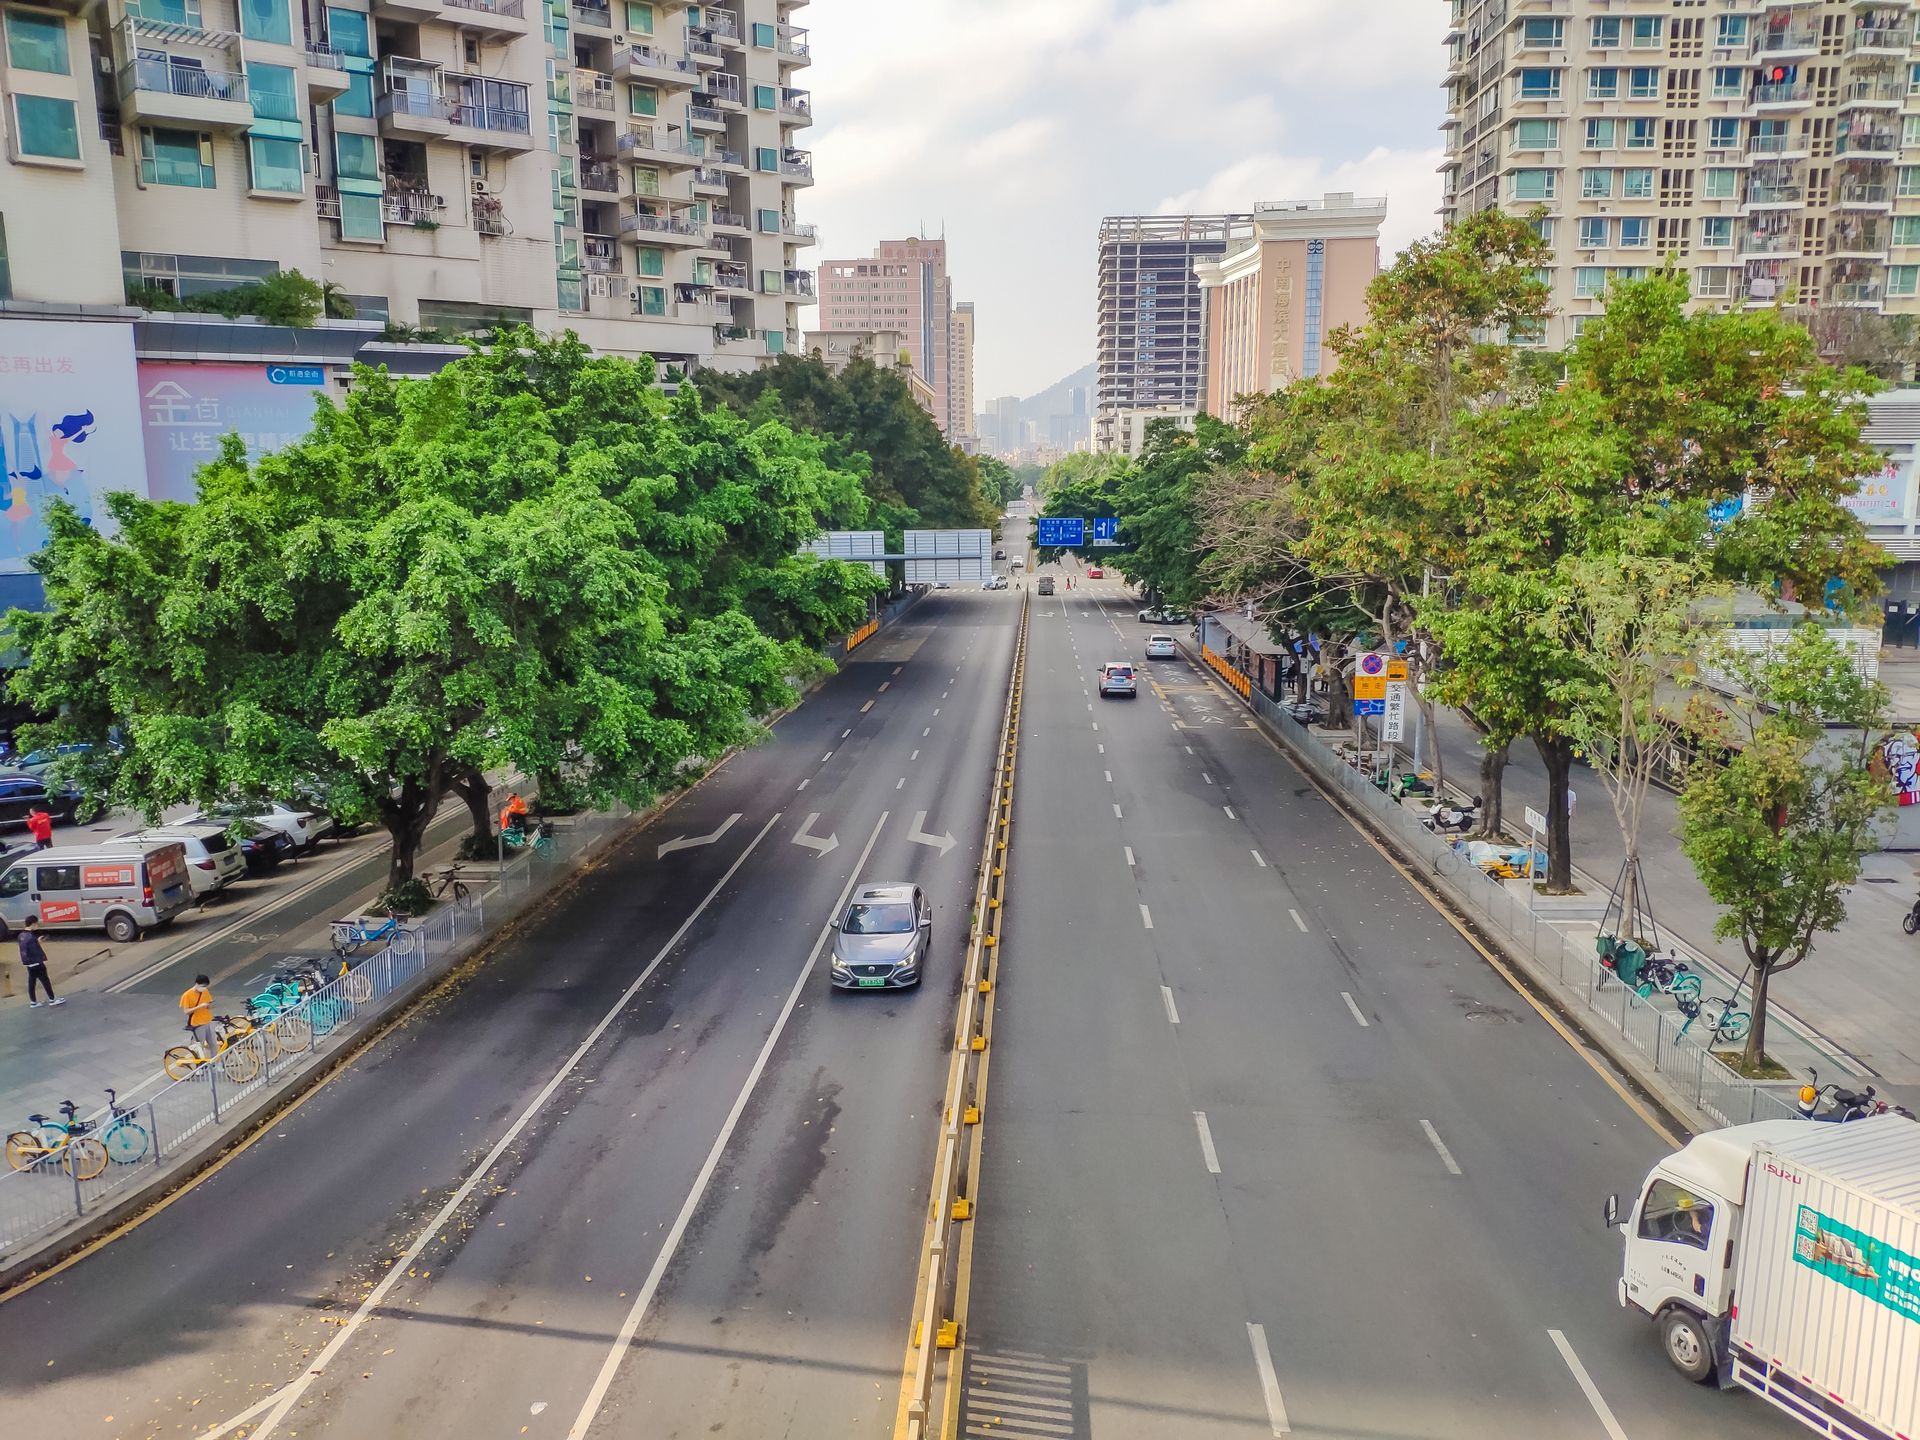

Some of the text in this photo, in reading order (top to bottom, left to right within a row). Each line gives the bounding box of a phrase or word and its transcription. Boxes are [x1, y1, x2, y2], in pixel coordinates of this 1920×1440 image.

[1388, 684, 1401, 740] 交通繁忙路段
[1763, 1162, 1802, 1185] ISUZU
